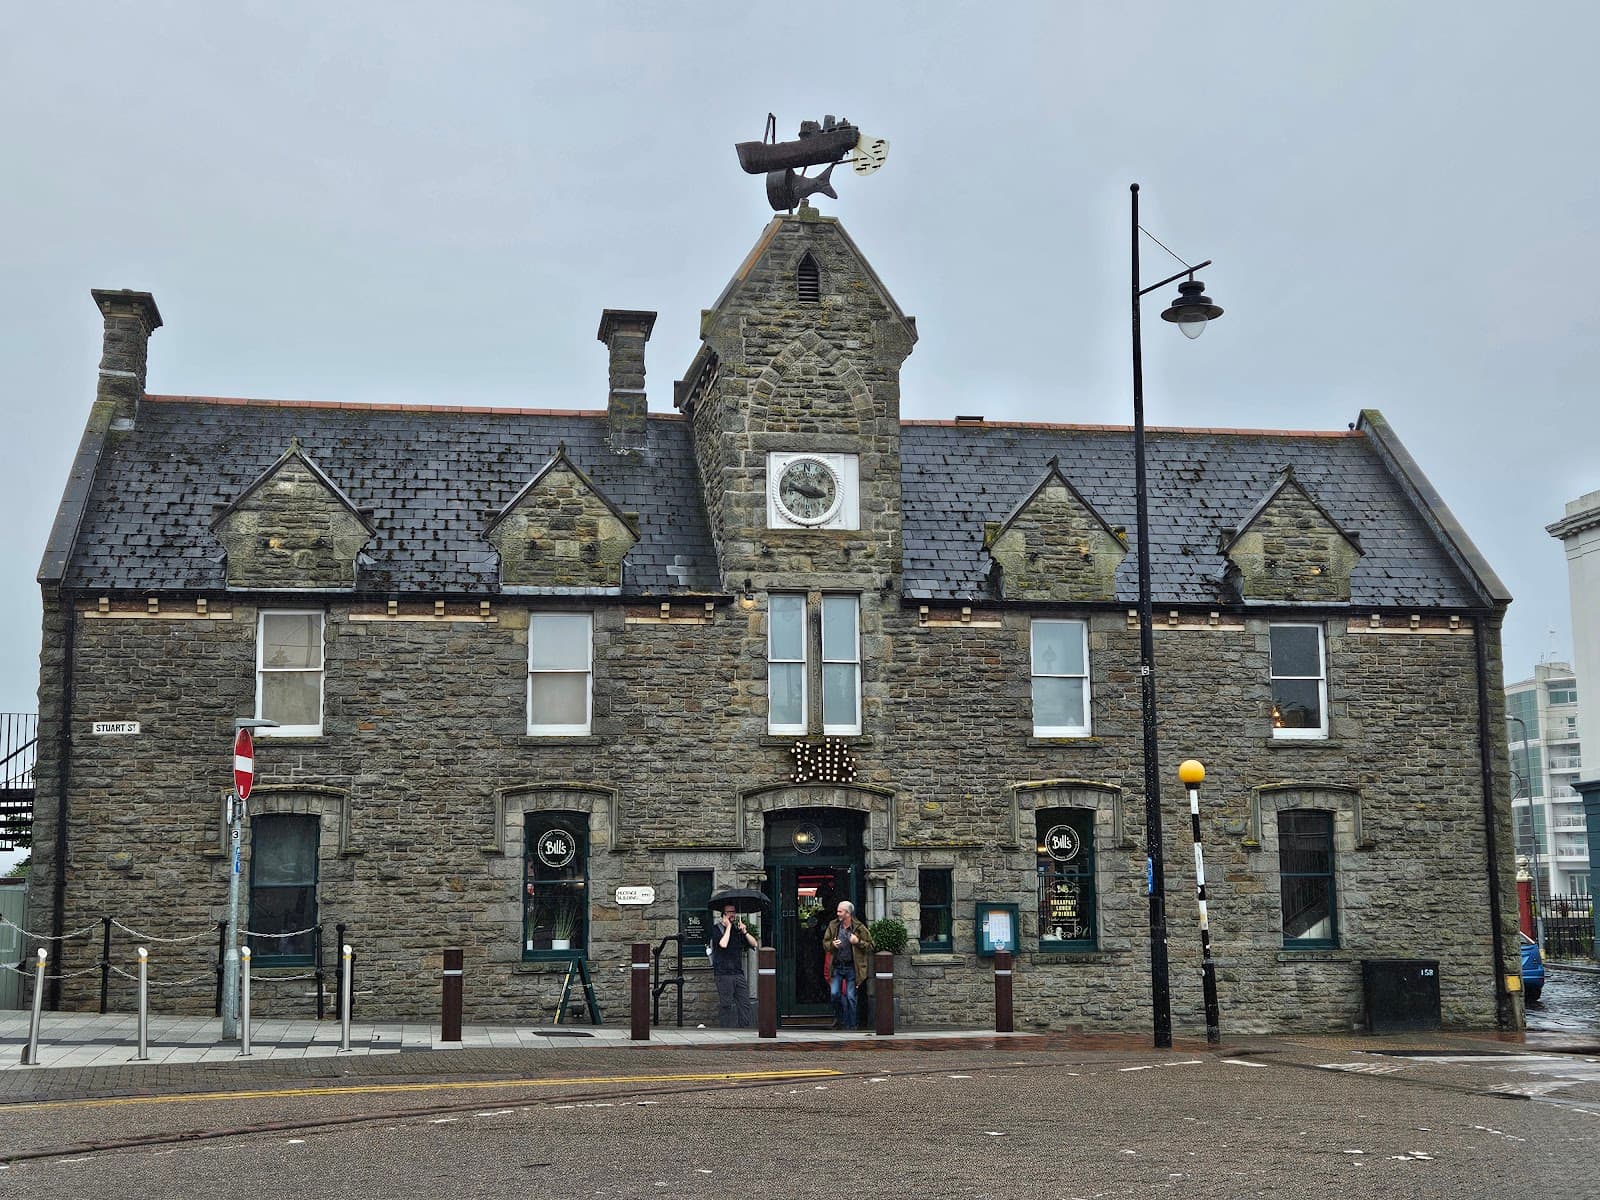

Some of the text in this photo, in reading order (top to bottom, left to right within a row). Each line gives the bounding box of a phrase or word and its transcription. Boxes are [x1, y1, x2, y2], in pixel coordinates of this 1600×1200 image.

[803, 463, 811, 472] N
[96, 723, 125, 732] STUART
[232, 831, 239, 839] 3
[1051, 834, 1073, 850] Bill's
[545, 839, 567, 855] Bill's
[1420, 968, 1434, 977] 158
